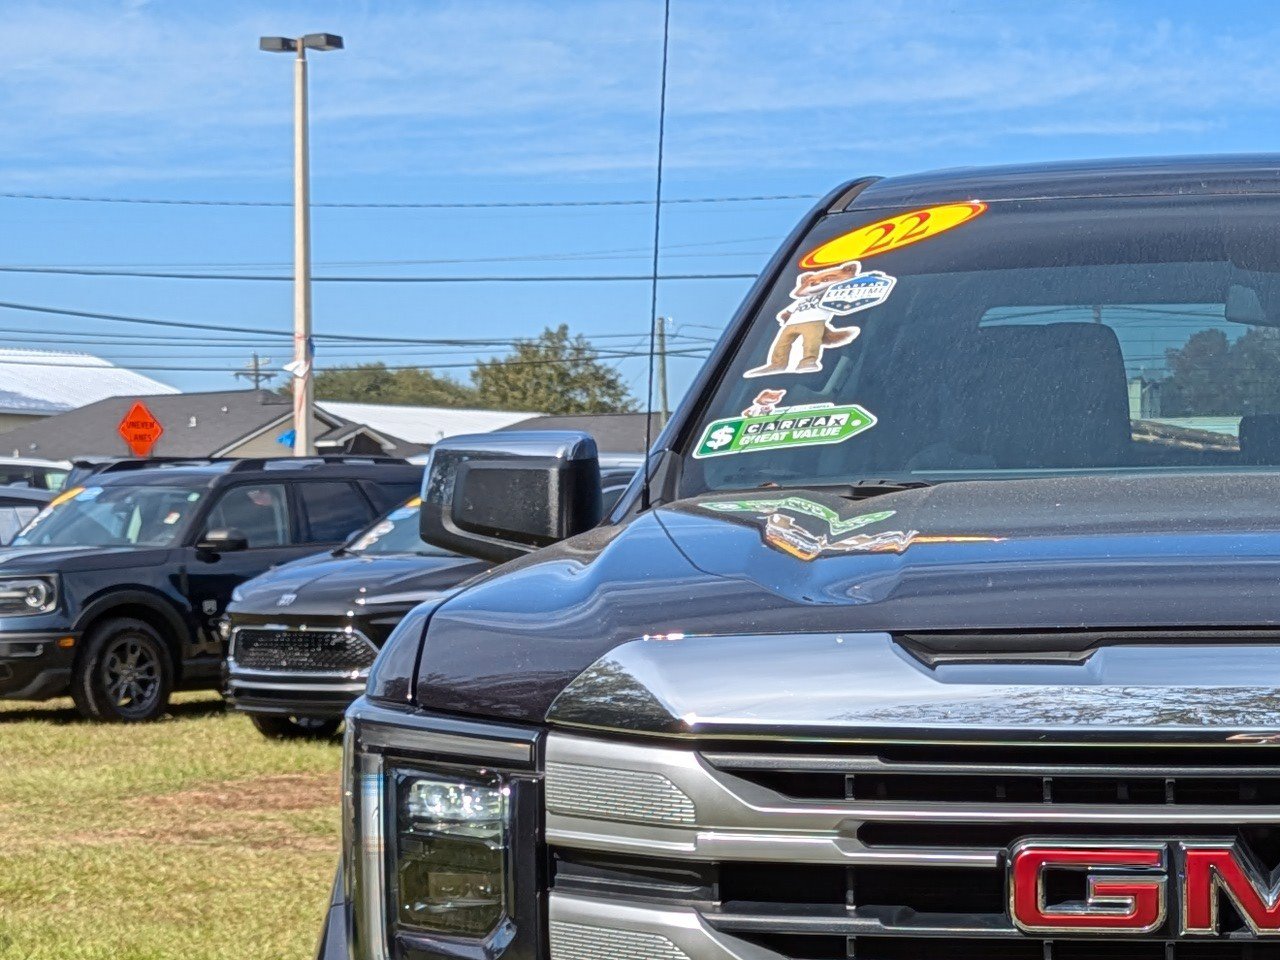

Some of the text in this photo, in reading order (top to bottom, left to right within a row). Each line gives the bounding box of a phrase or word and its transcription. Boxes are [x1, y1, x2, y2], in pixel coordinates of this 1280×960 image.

[860, 212, 931, 255] 22
[745, 413, 850, 435] CARFAX
[738, 426, 843, 446] GREAT VALUE
